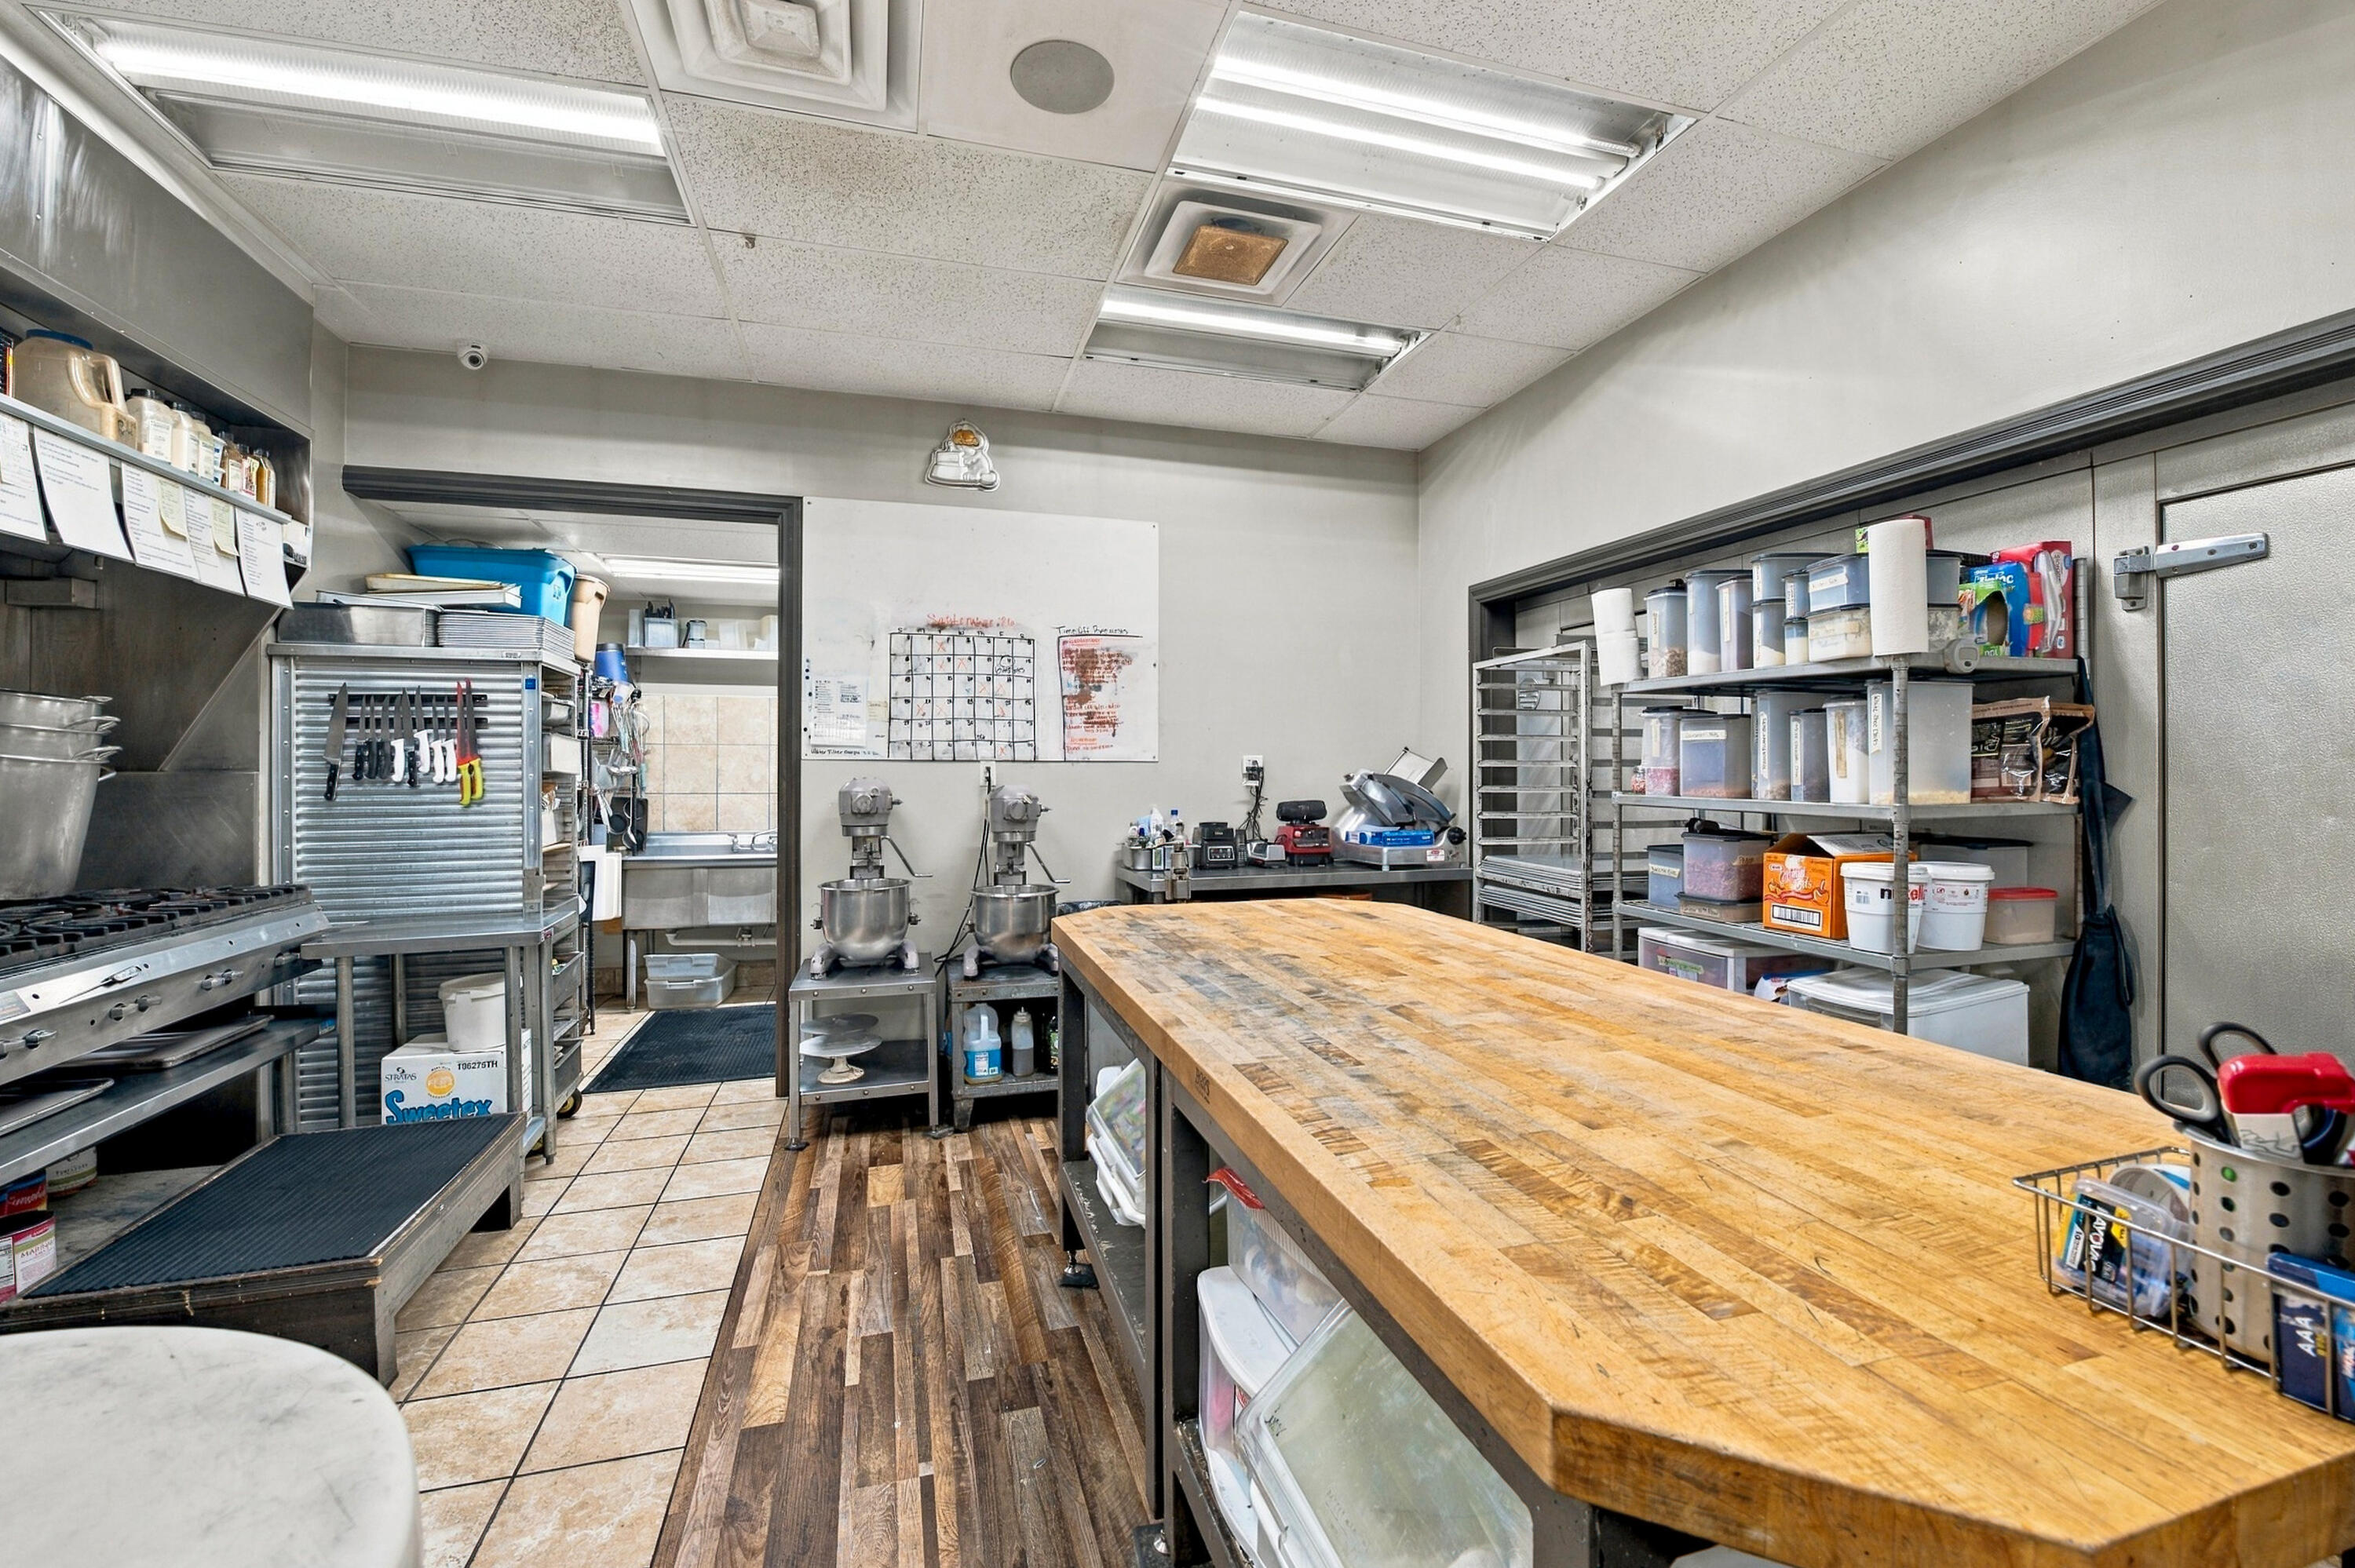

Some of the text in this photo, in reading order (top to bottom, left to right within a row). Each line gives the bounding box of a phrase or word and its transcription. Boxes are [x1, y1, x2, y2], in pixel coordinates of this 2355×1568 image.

[385, 1073, 417, 1082] STRATAS
[385, 1089, 493, 1125] Sweetex
[2295, 1315, 2317, 1358] AAA
